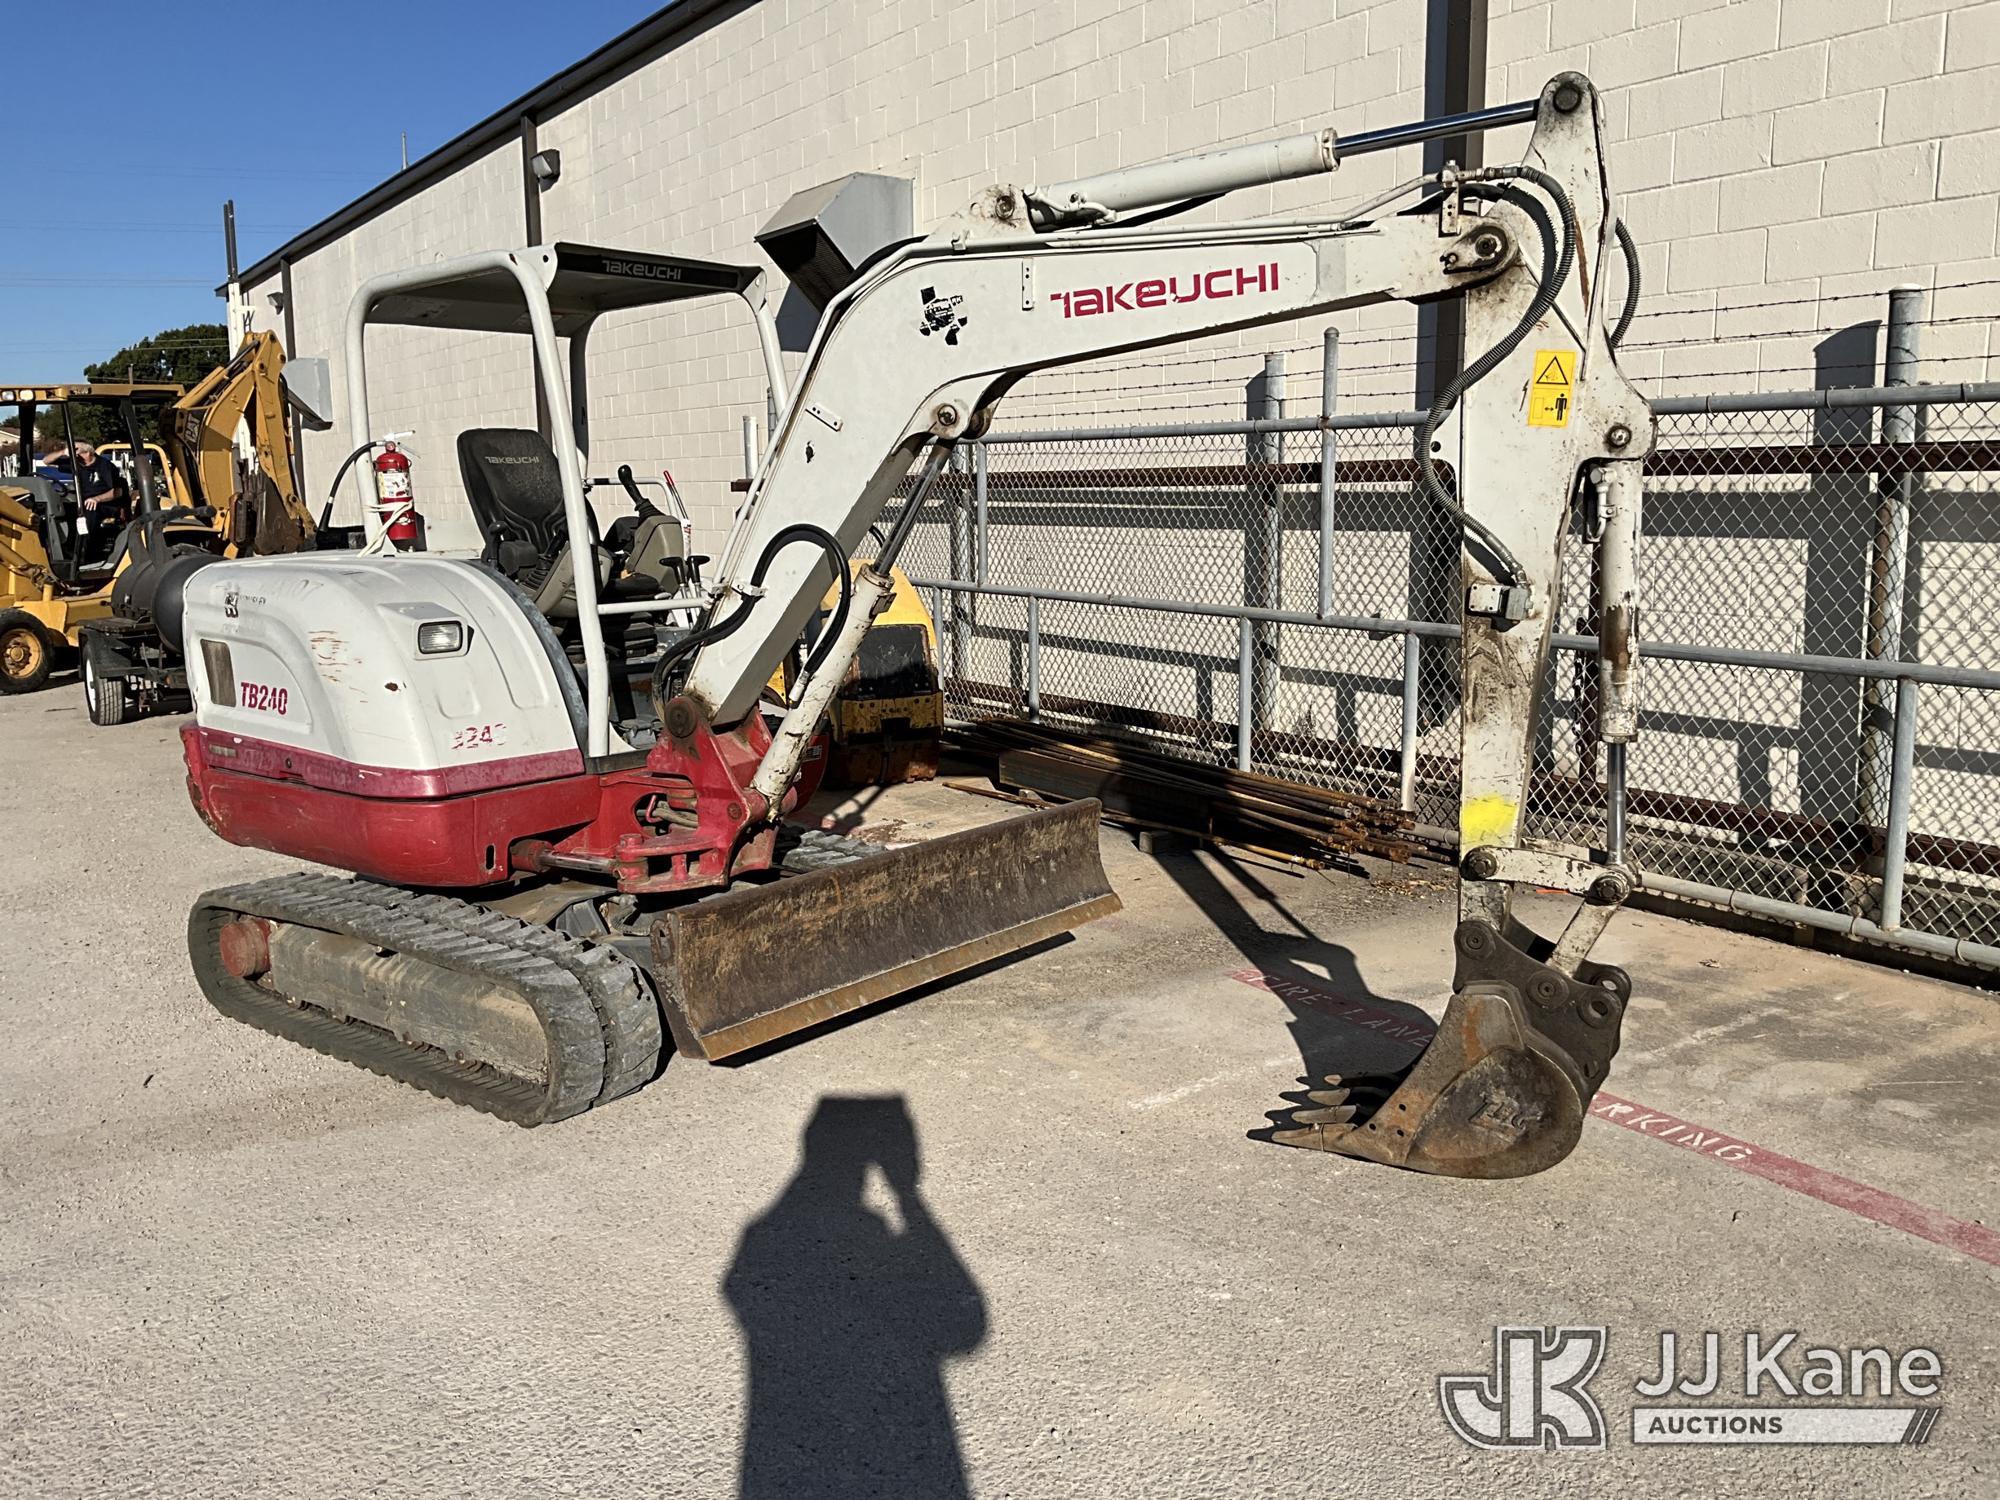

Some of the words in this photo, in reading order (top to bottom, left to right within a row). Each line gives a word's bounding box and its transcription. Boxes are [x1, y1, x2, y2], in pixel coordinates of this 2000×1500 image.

[241, 682, 288, 715] TB240
[1248, 975, 1332, 1005] FIRE
[1593, 1095, 1753, 1161] RKING
